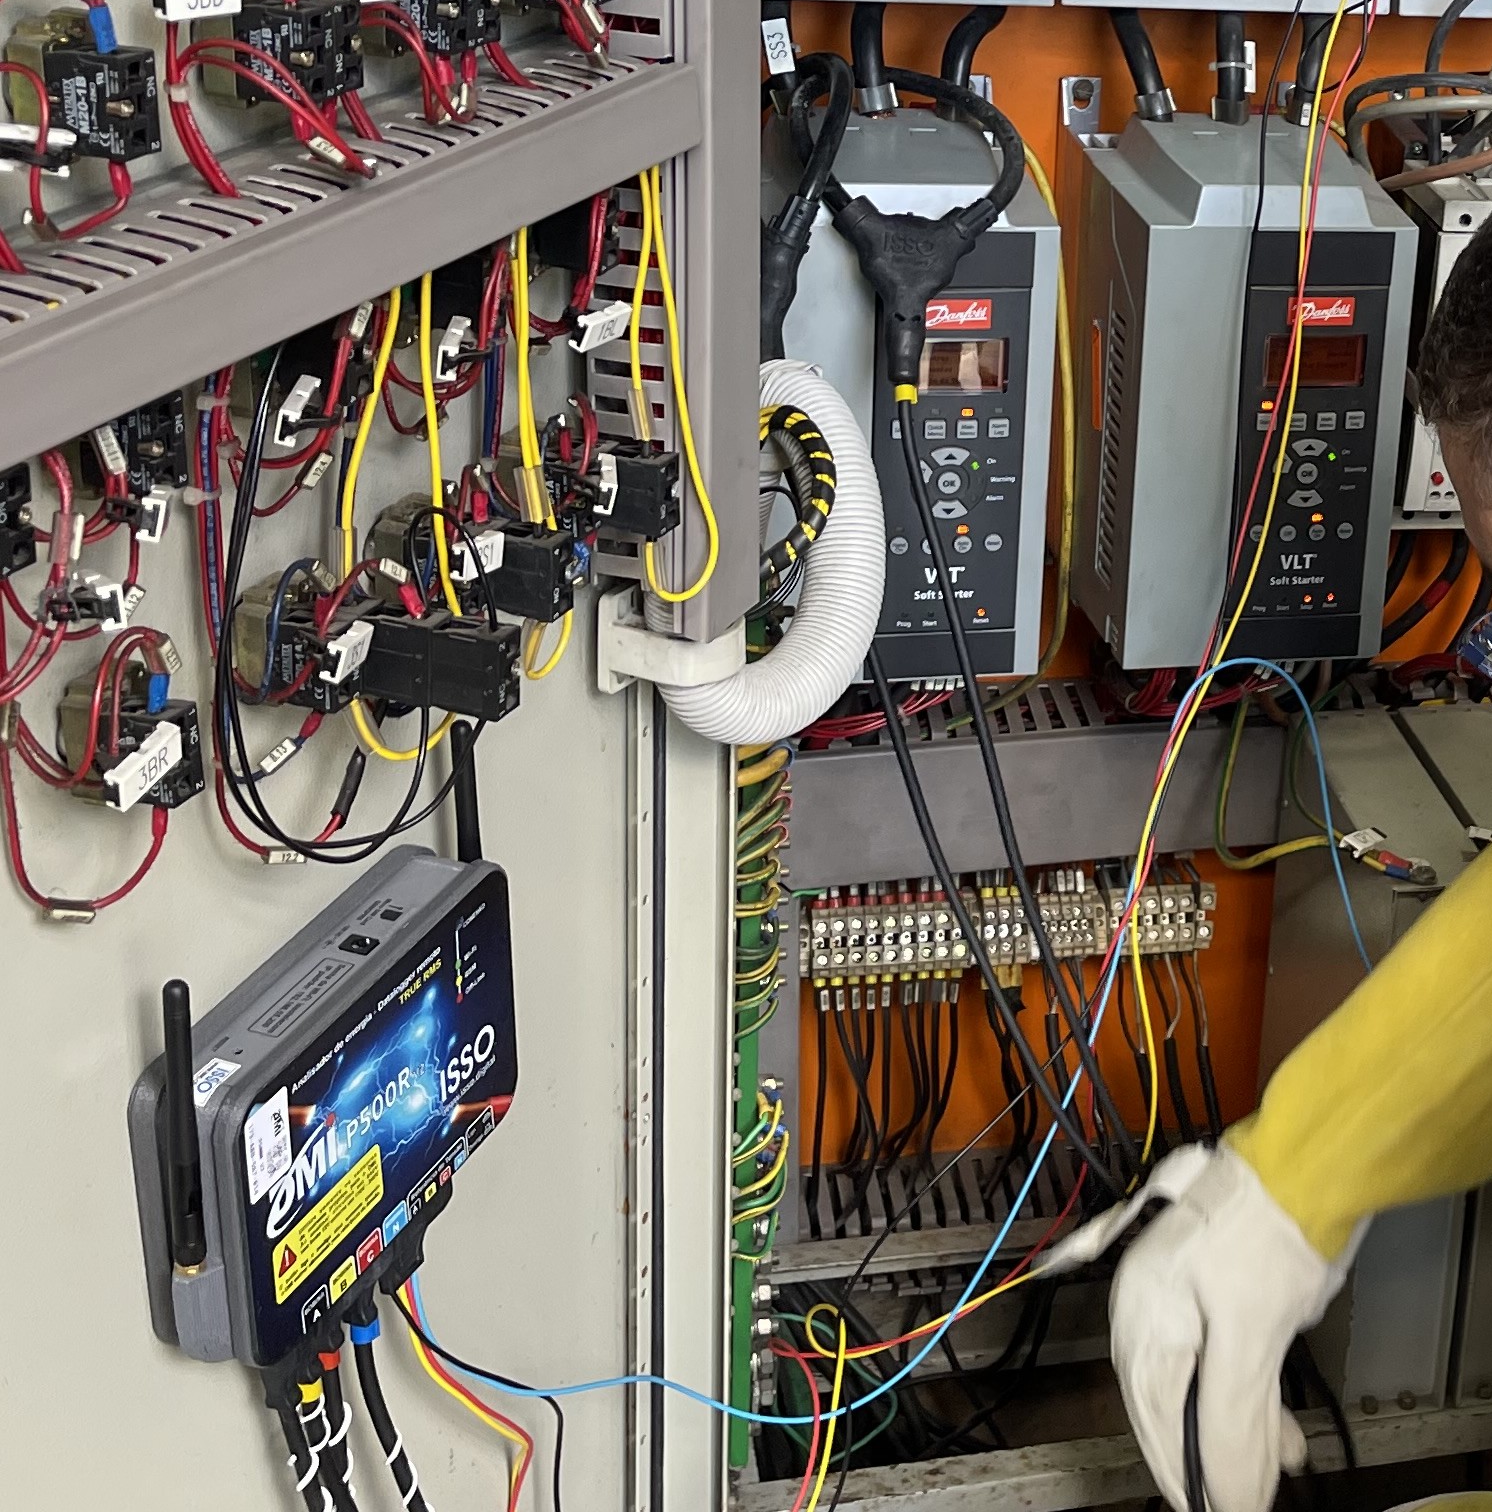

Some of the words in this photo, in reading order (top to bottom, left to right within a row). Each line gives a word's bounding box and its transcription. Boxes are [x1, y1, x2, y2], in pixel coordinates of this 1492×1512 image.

[770, 32, 788, 59] SS3
[146, 76, 156, 98] NC
[75, 76, 90, 134] M20-1B
[926, 301, 988, 327] Danfoss
[1292, 300, 1351, 324] Danfoss
[942, 479, 956, 488] OK
[1280, 554, 1313, 570] VLT
[924, 567, 964, 584] VT
[1270, 575, 1290, 586] Soft
[1292, 574, 1325, 585] Starter
[914, 589, 936, 601] Soft
[938, 589, 974, 600] Srter
[139, 747, 169, 791] 3BR
[398, 976, 422, 1005] TRUE
[422, 958, 443, 982] RMS
[291, 1046, 333, 1095] Analisador
[345, 1012, 373, 1043] energia
[377, 970, 416, 1011] Datalogger
[439, 1024, 495, 1103] ISSO
[346, 1066, 410, 1148] P500R
[312, 1308, 322, 1323] A
